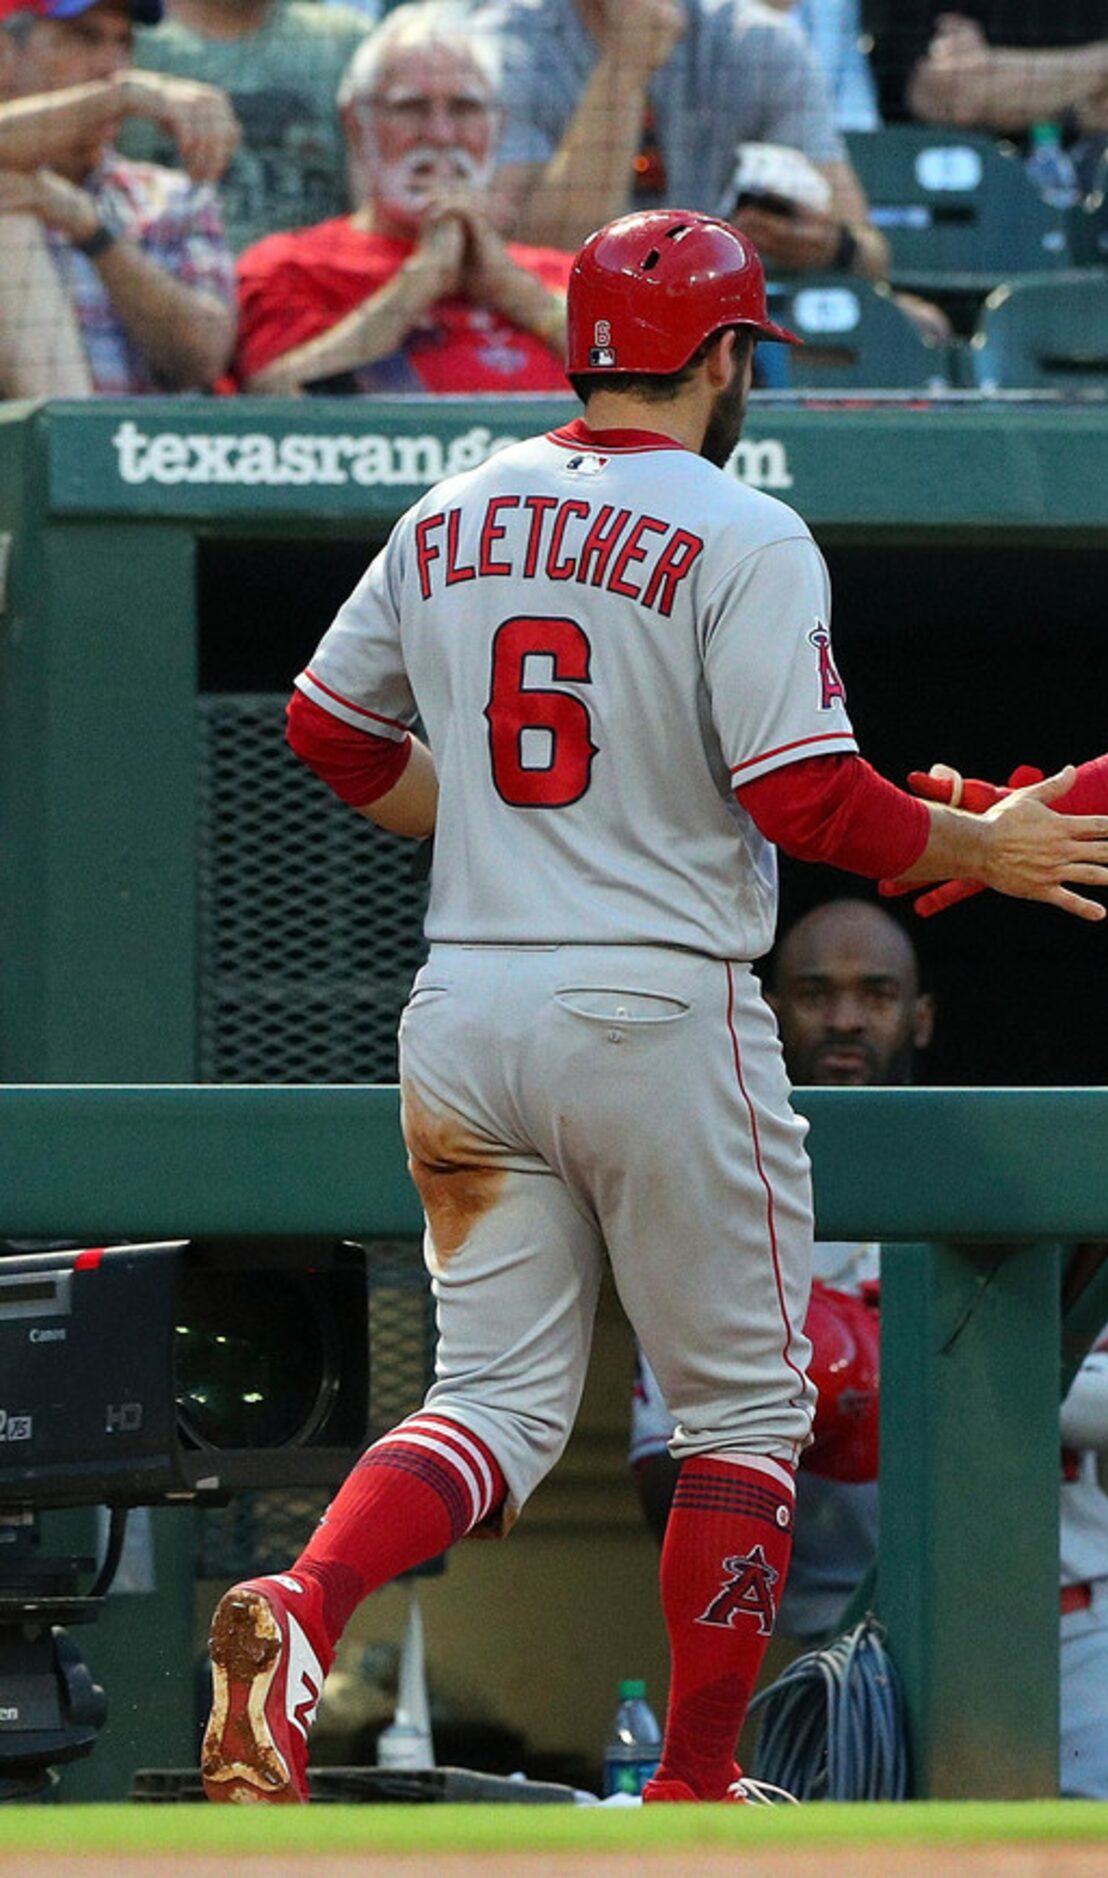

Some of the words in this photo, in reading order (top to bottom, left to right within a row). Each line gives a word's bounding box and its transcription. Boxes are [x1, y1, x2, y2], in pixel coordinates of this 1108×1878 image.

[594, 319, 611, 347] 6
[414, 495, 704, 617] FLETCHER
[482, 615, 601, 810] 6
[693, 1544, 780, 1636] A
